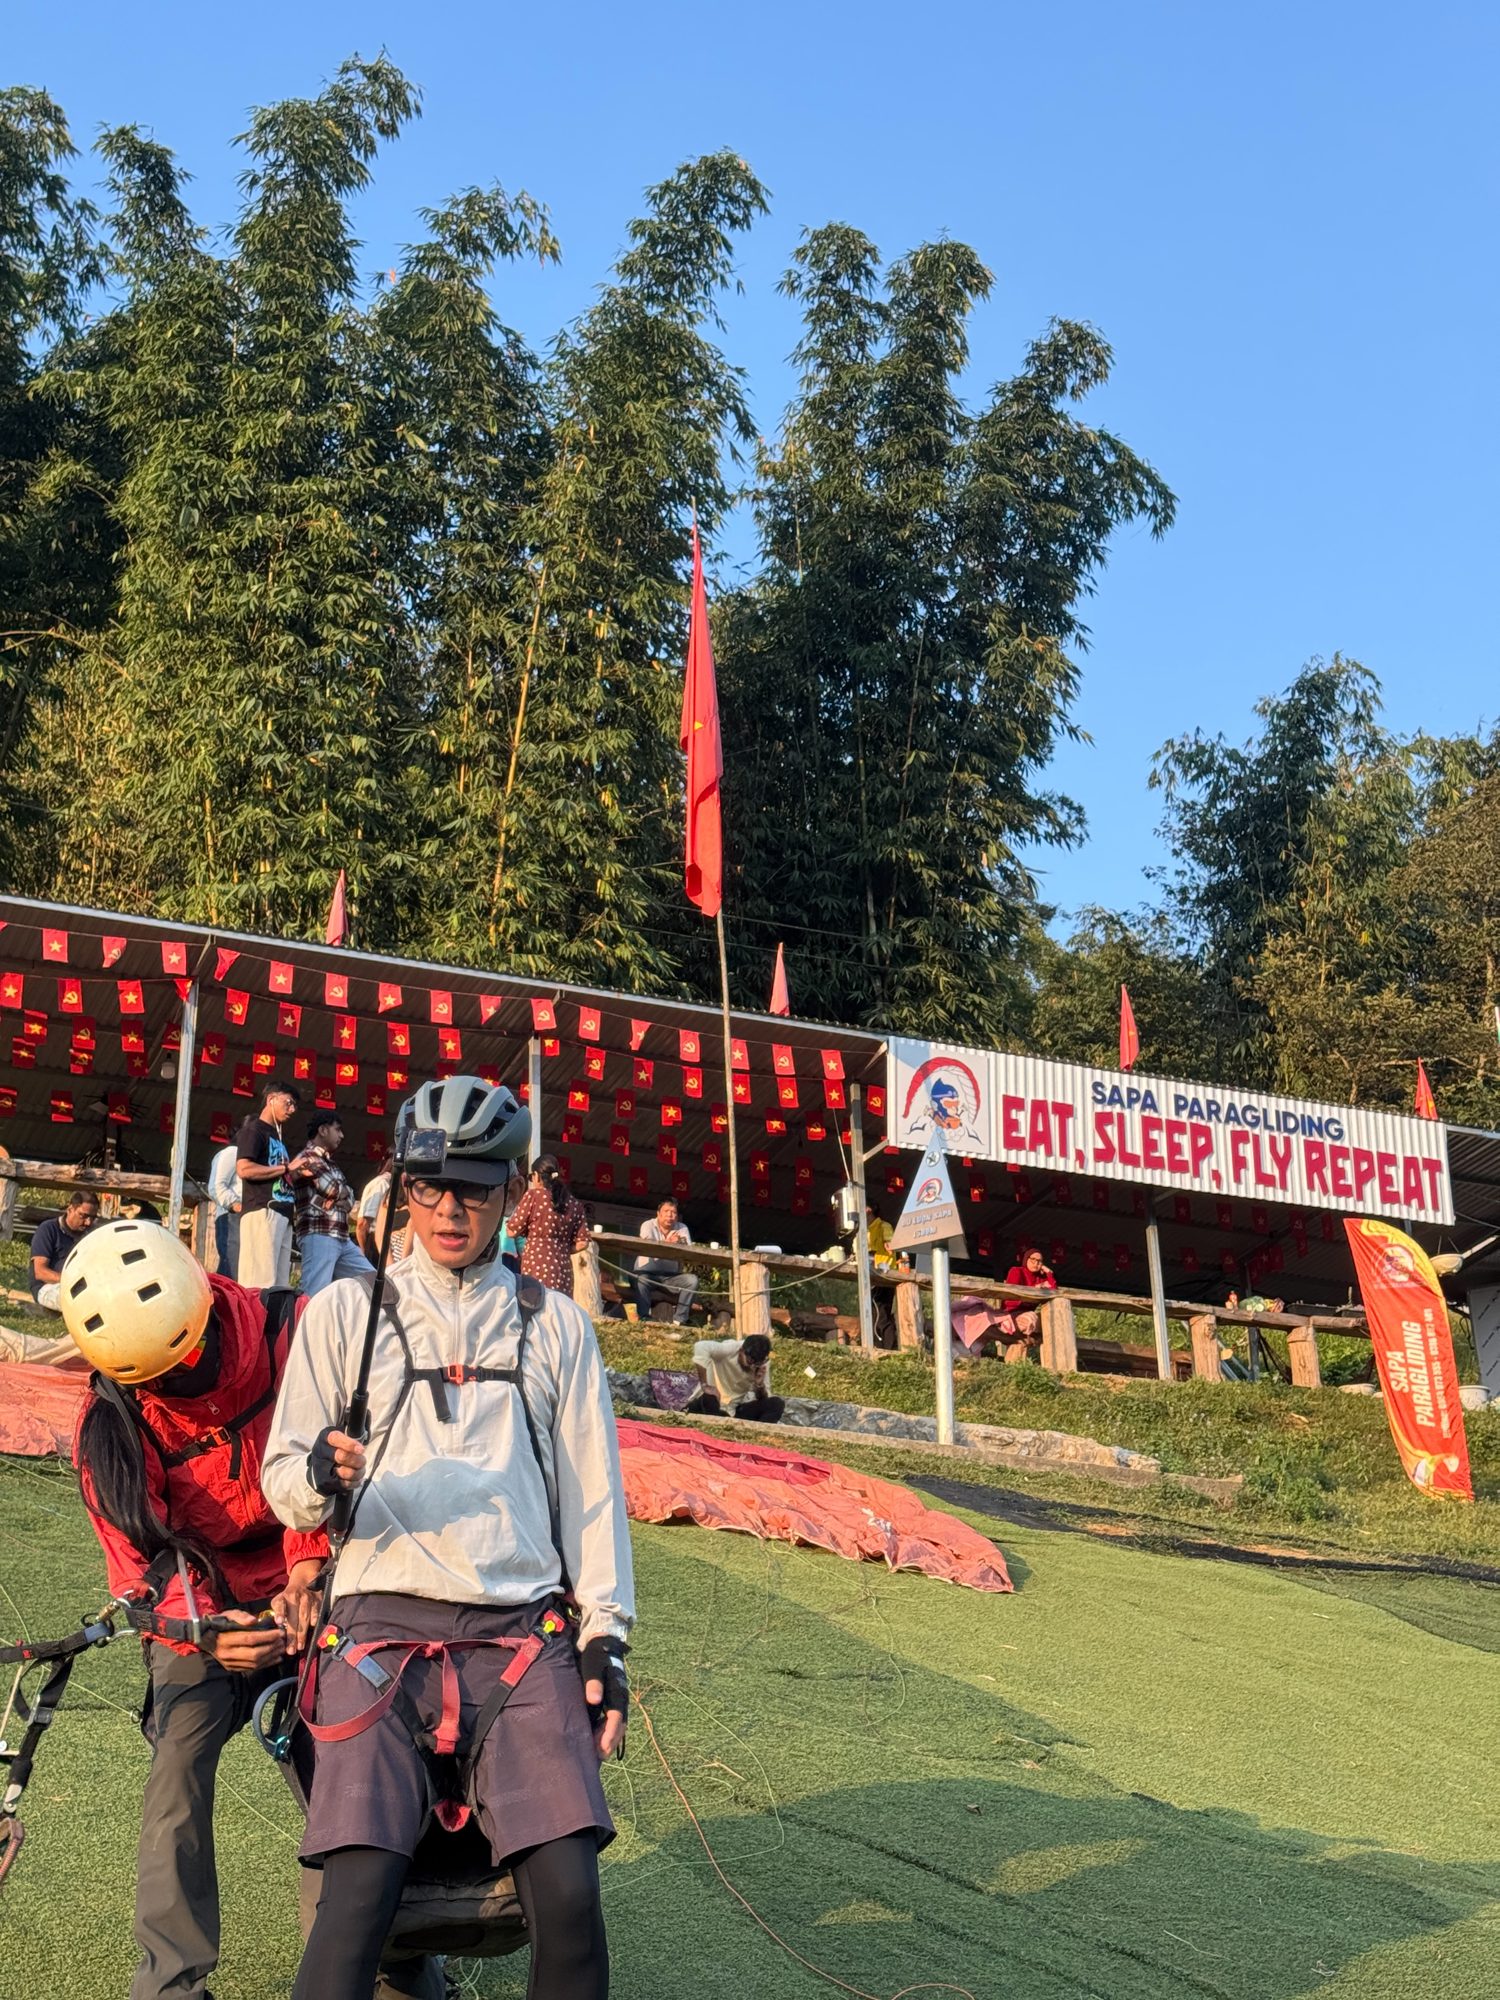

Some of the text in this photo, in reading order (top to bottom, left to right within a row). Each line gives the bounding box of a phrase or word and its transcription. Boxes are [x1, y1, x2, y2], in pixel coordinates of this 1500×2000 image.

[1092, 1081, 1344, 1140] SAPA PARAGLIDING
[1002, 1094, 1443, 1212] EAT, SLEEP, FLY REPEAT
[1386, 1350, 1410, 1393] SAPA
[1401, 1320, 1436, 1428] PARAGLIDING
